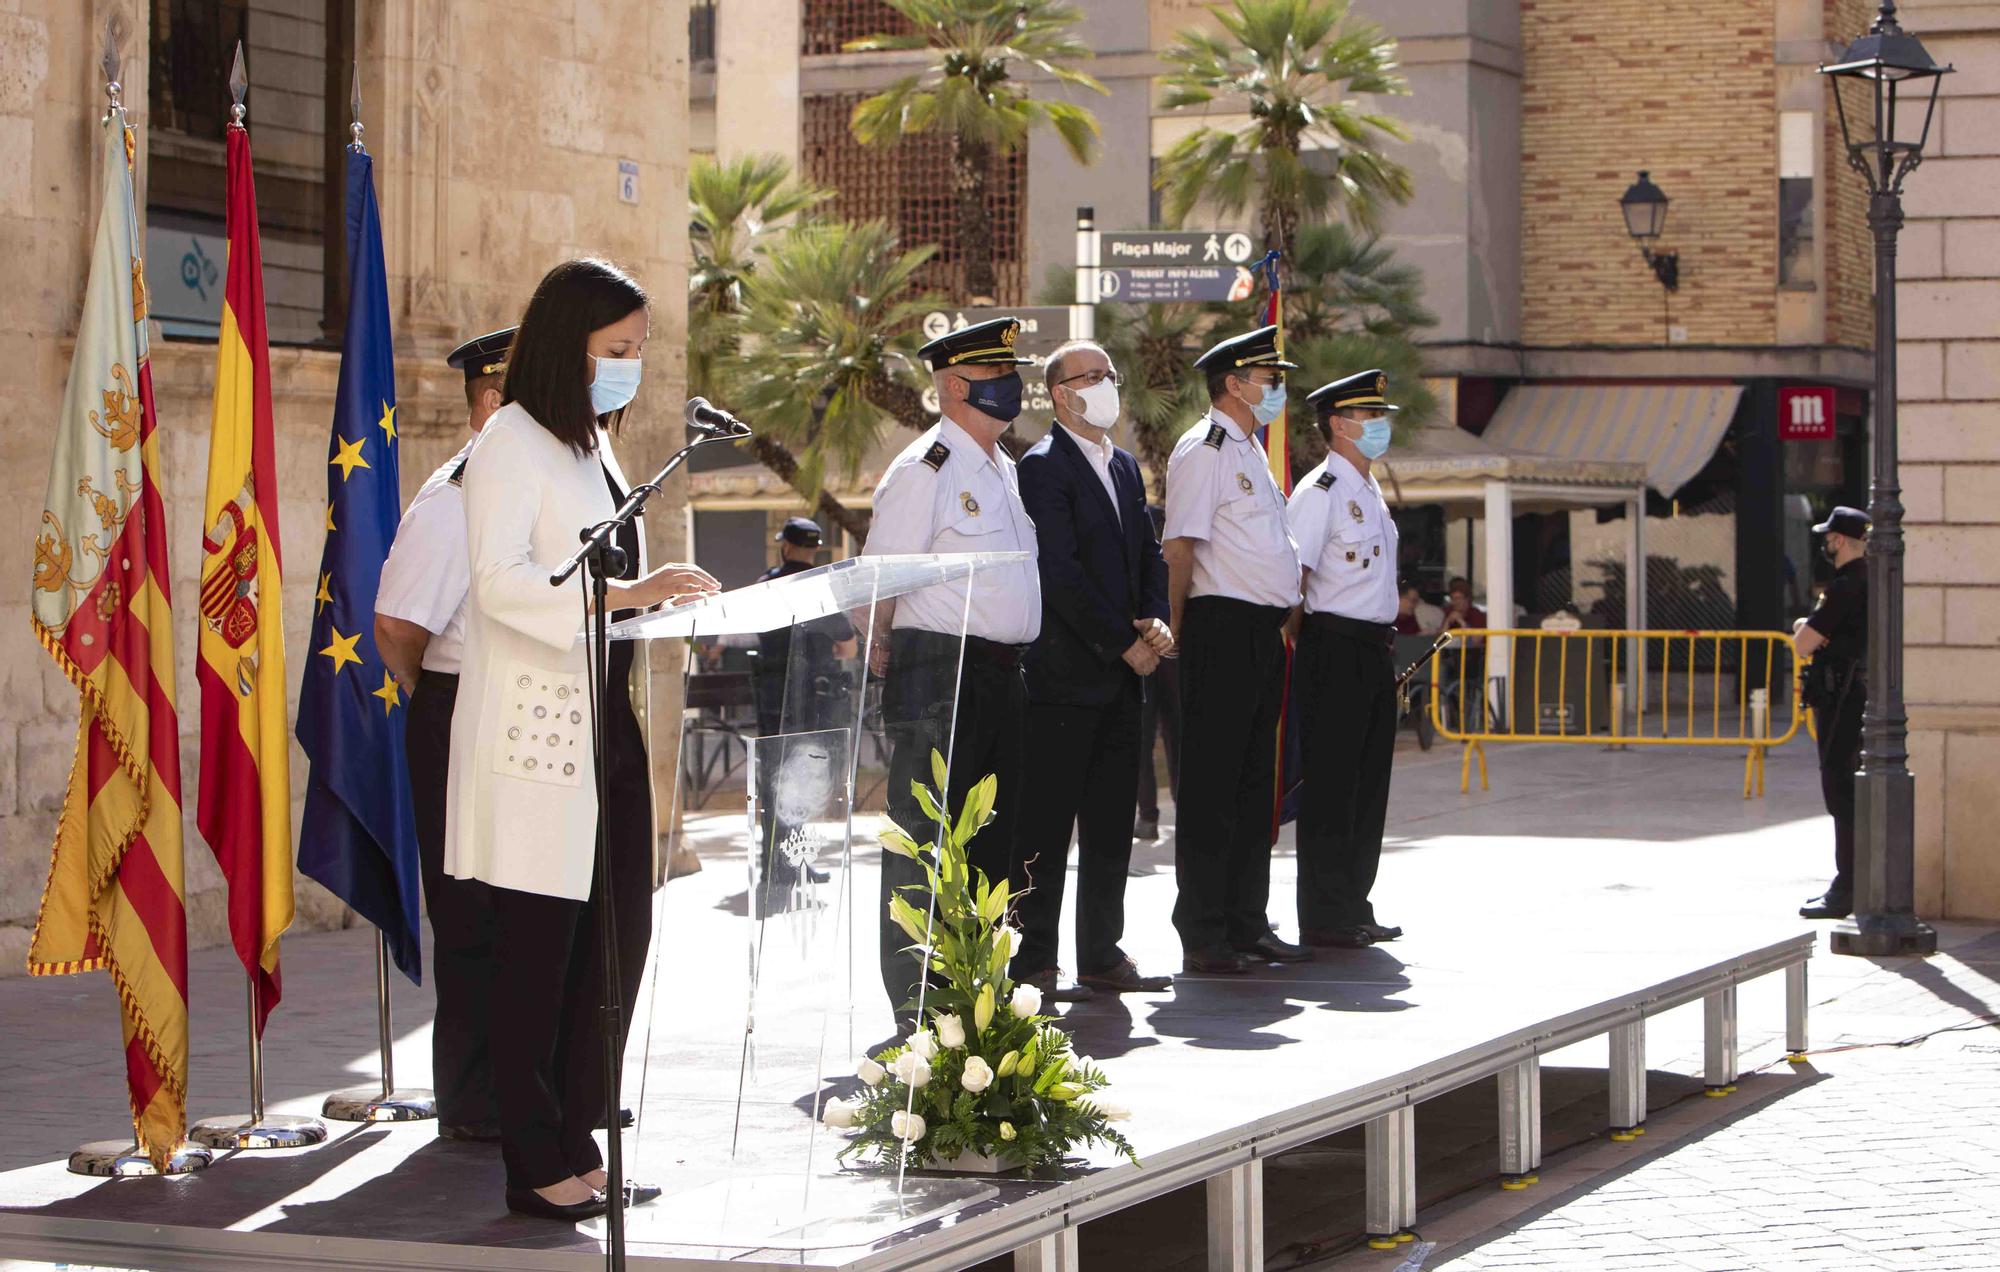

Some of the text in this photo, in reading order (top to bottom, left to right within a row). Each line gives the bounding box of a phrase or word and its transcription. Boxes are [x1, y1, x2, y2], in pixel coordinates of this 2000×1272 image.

[624, 176, 633, 199] 6
[1112, 241, 1192, 259] Plaça Major
[1130, 269, 1220, 279] TOURIST INFO ALZIRA
